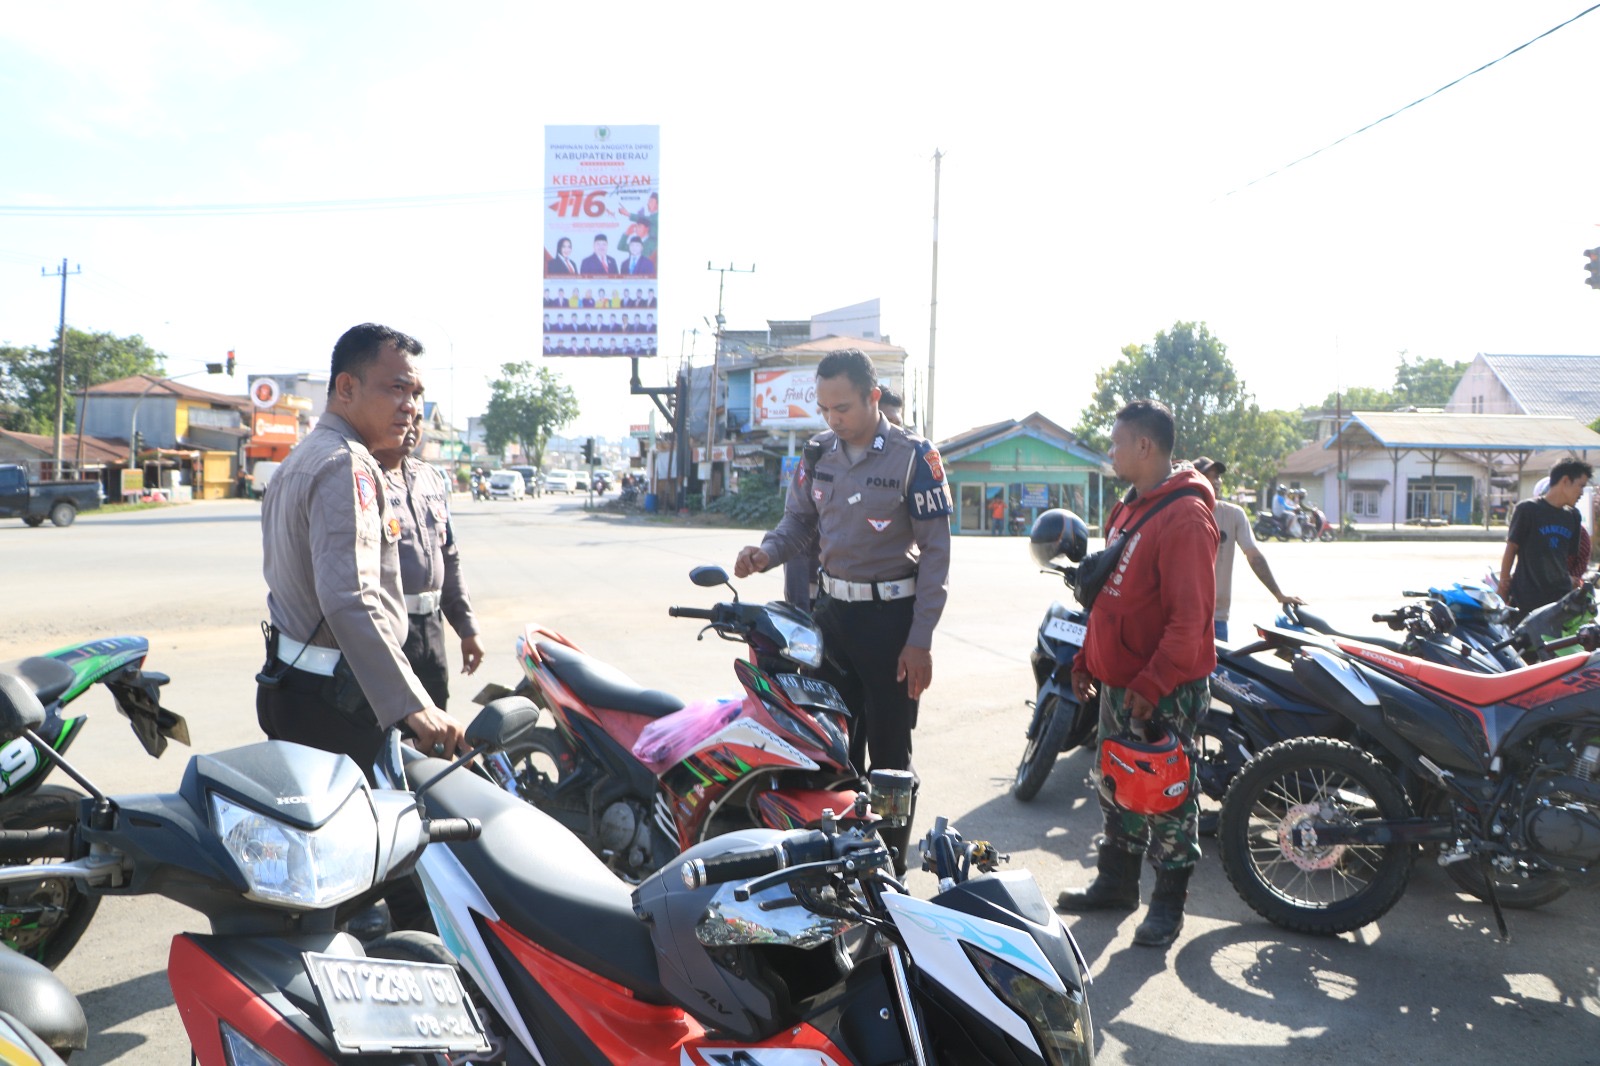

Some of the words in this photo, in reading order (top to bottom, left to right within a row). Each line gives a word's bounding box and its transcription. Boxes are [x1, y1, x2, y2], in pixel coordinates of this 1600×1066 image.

[555, 152, 613, 160] KABUPATEN
[616, 152, 648, 160] BERAU
[552, 175, 651, 185] KEBANGKITAN
[557, 189, 608, 218] 116
[866, 477, 900, 489] POLRI
[1360, 649, 1405, 670] HONDA
[320, 961, 361, 1001] KT
